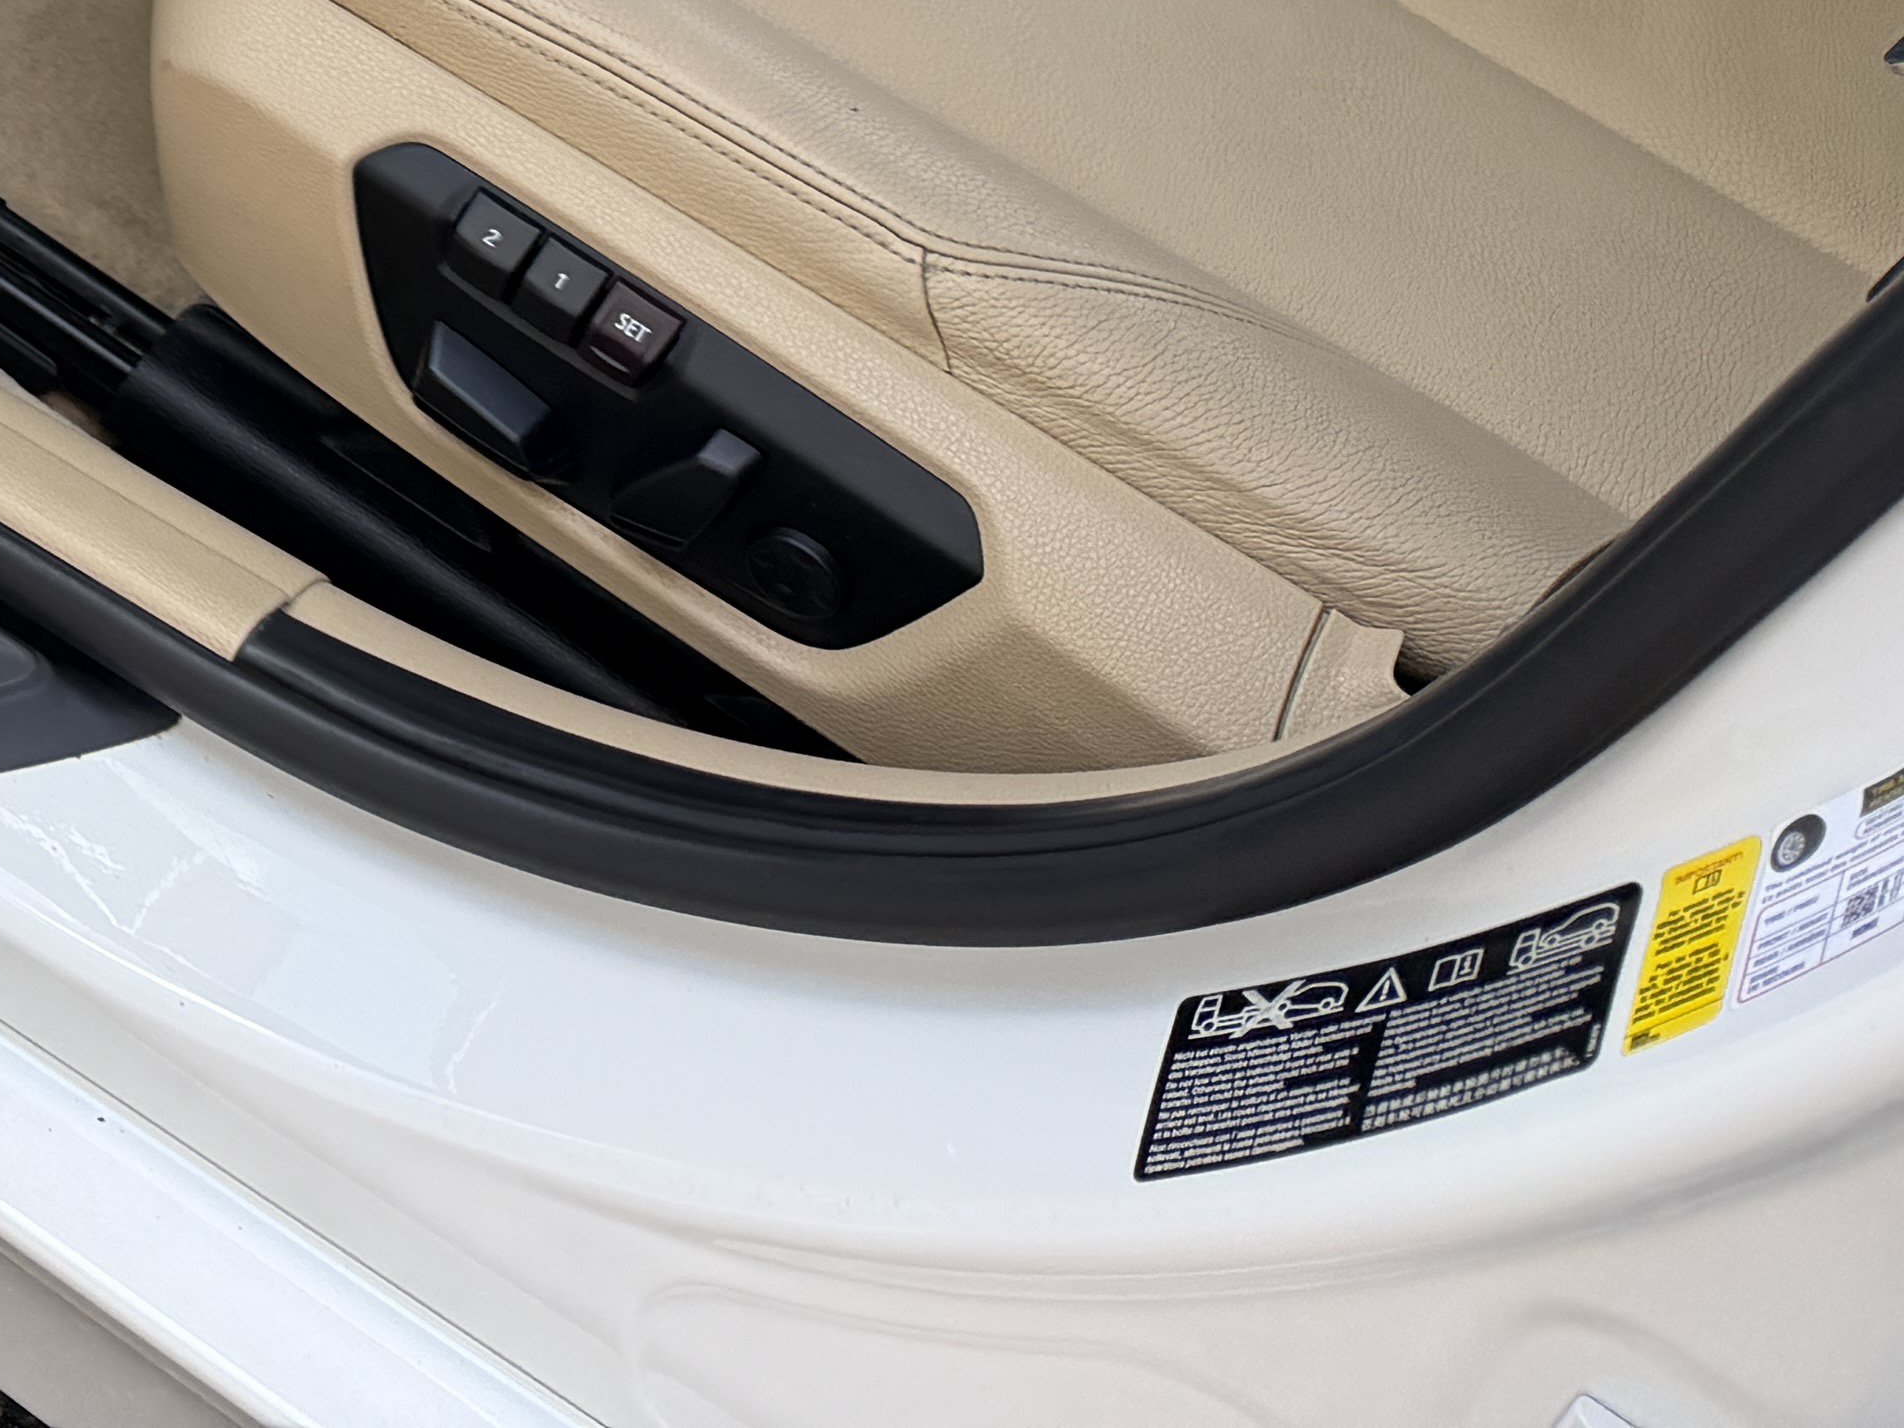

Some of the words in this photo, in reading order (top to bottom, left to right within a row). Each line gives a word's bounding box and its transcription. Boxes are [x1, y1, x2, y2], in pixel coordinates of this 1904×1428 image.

[481, 228, 503, 248] 2
[553, 272, 570, 291] 1
[614, 312, 653, 344] SET
